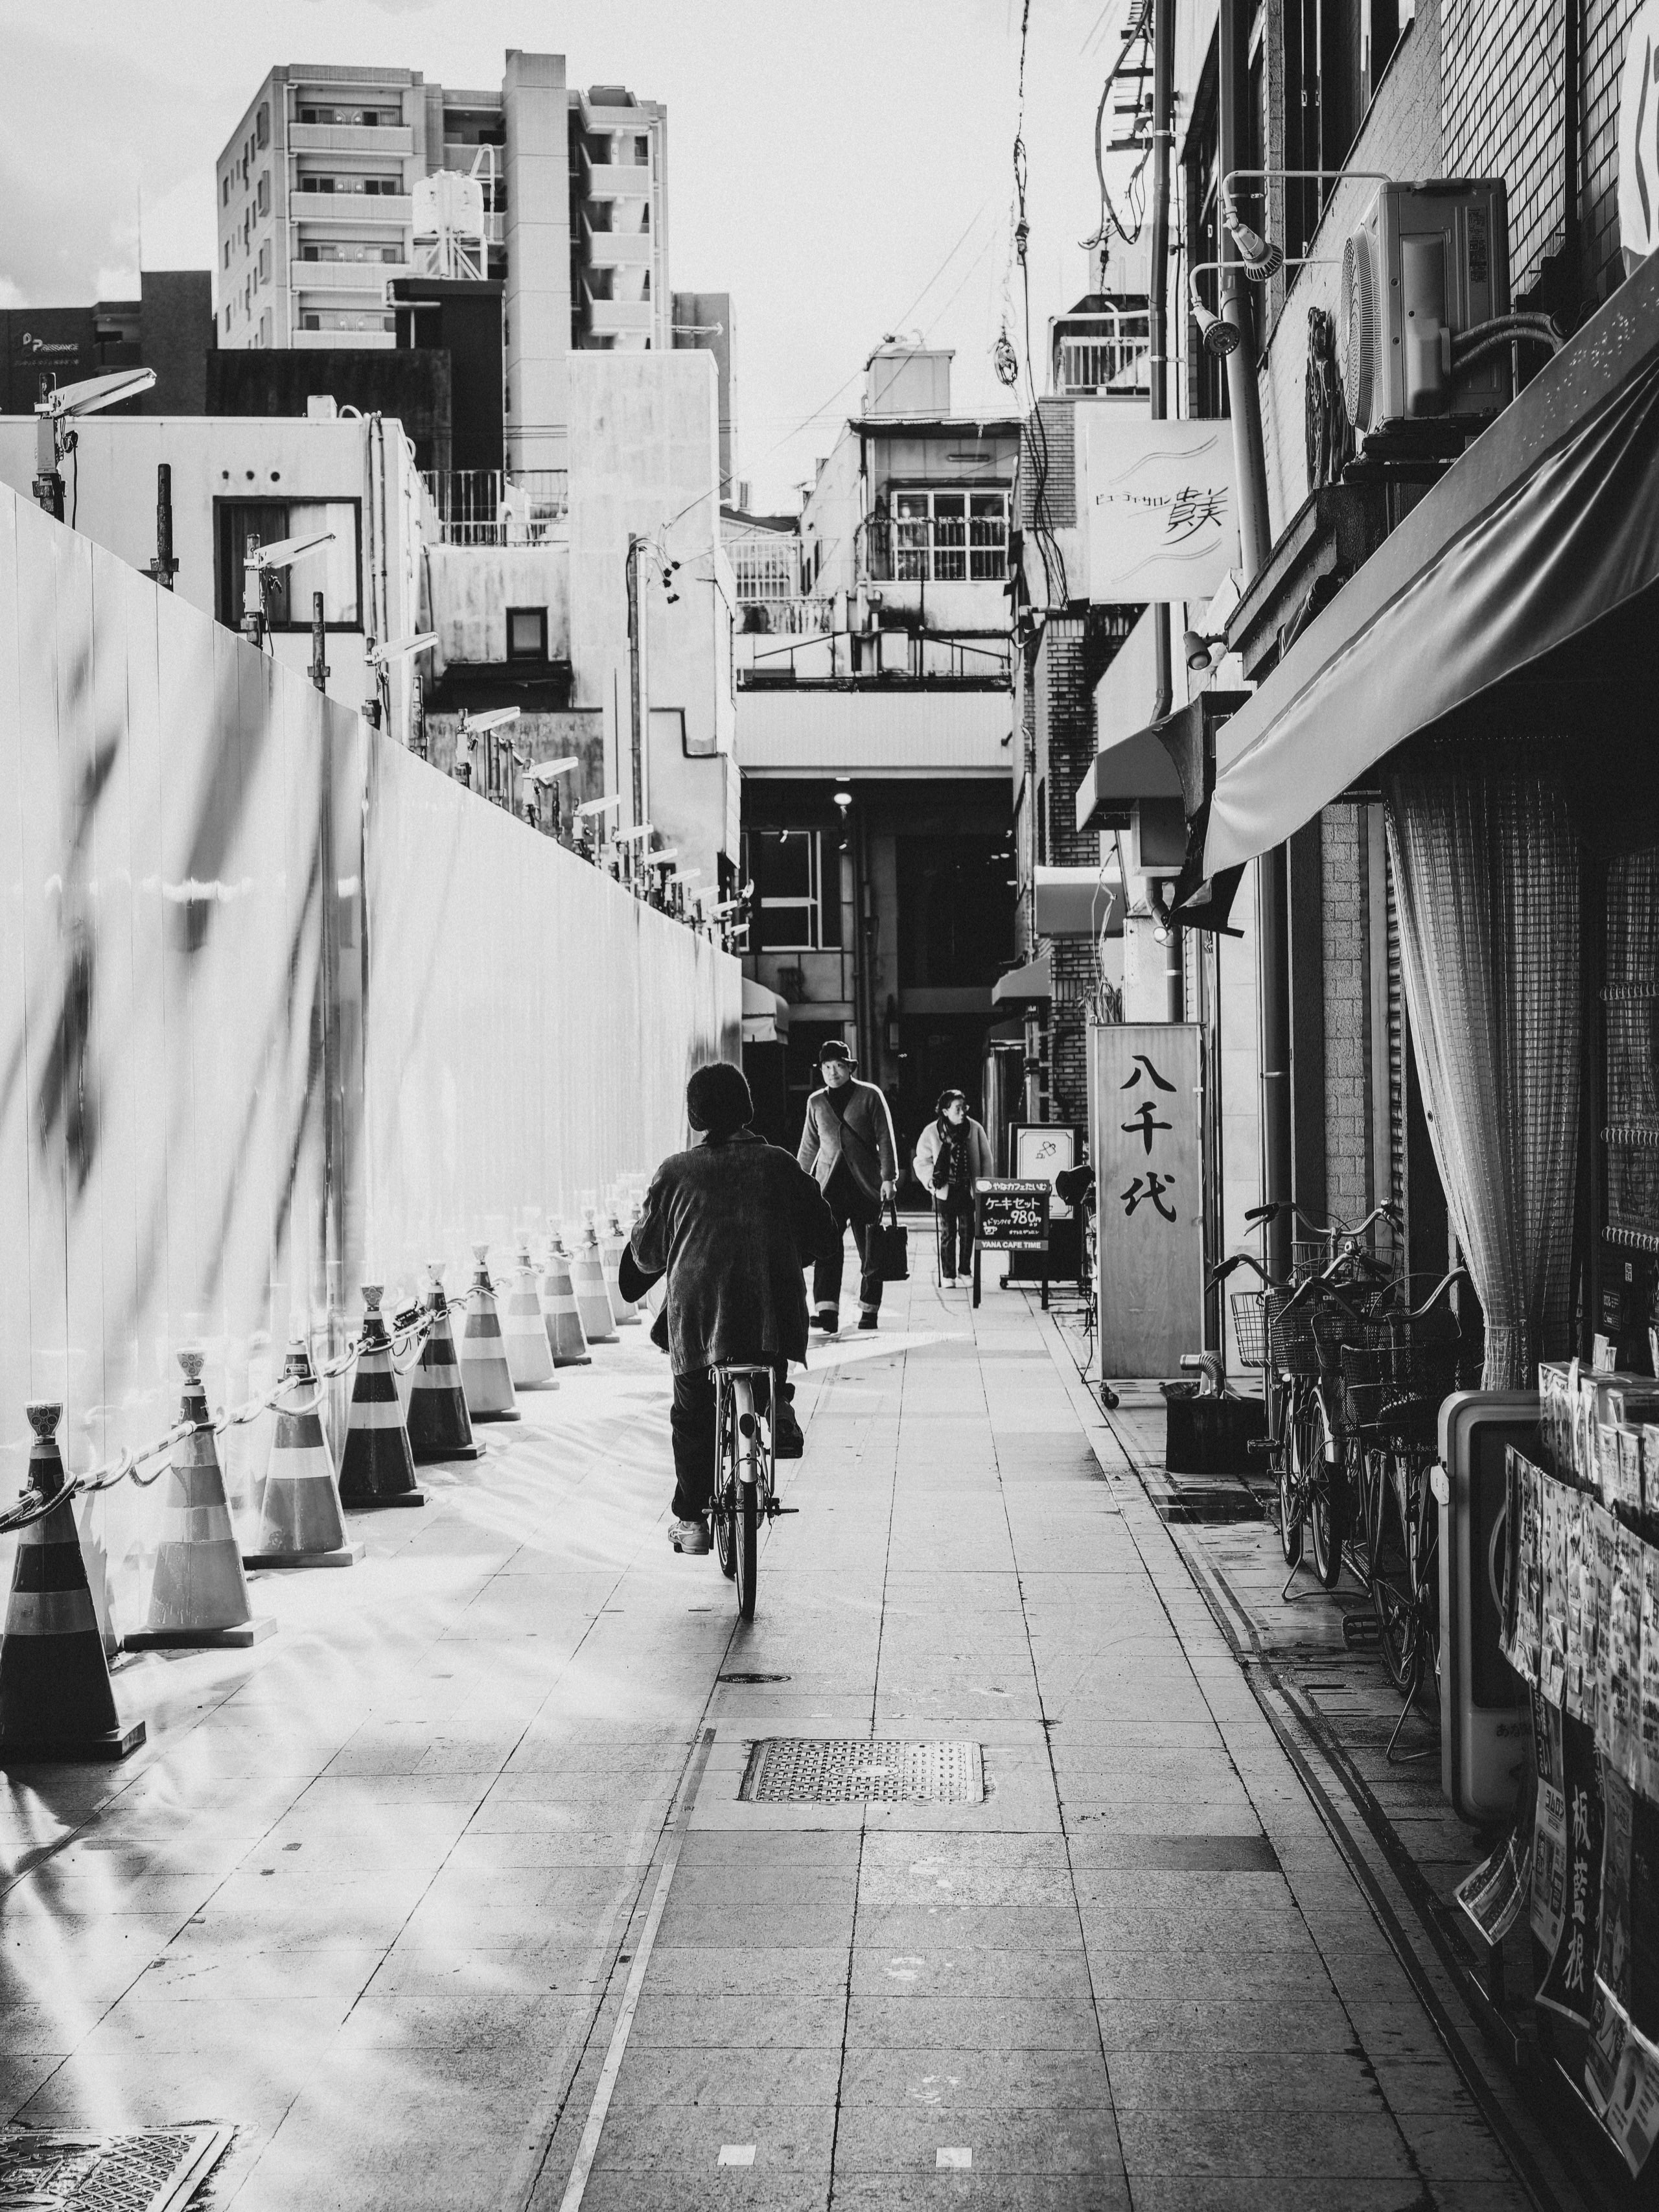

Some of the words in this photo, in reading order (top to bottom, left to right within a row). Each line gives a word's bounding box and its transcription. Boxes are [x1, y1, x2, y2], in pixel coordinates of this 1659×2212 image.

[1119, 1054, 1178, 1224] 八千代
[985, 1196, 1041, 1211] ケーキセット
